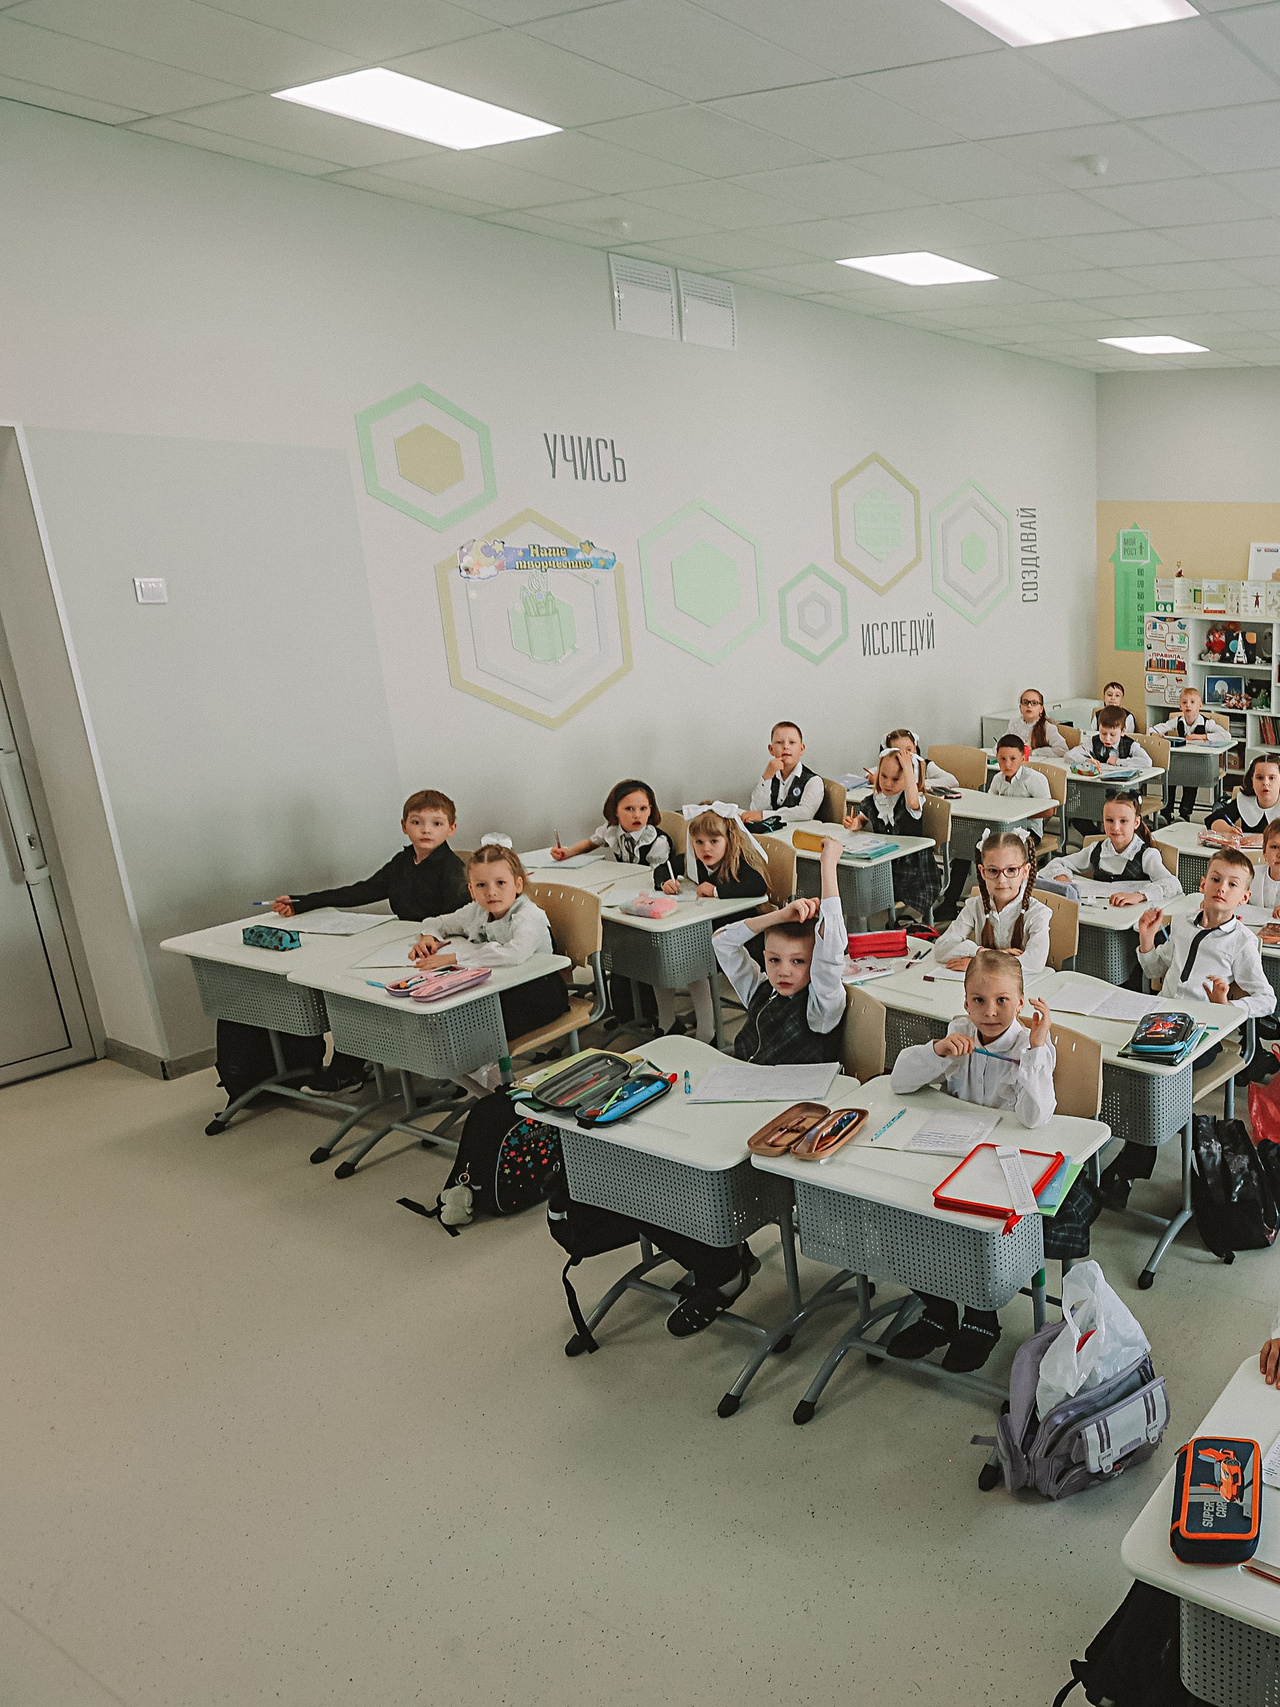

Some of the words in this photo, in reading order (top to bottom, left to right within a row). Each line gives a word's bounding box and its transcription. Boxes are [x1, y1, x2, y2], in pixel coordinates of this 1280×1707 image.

[543, 432, 626, 482] УЧИСЬ
[1123, 537, 1136, 546] МОЙ
[528, 544, 568, 558] Наше
[1016, 507, 1040, 602] СОЗДАВАЙ
[1123, 547, 1137, 556] РОСТ
[515, 560, 592, 572] творчество
[861, 612, 935, 656] ИССЛЕДУЙ
[1202, 1501, 1215, 1528] SUPER
[1216, 1501, 1228, 1518] CAR
